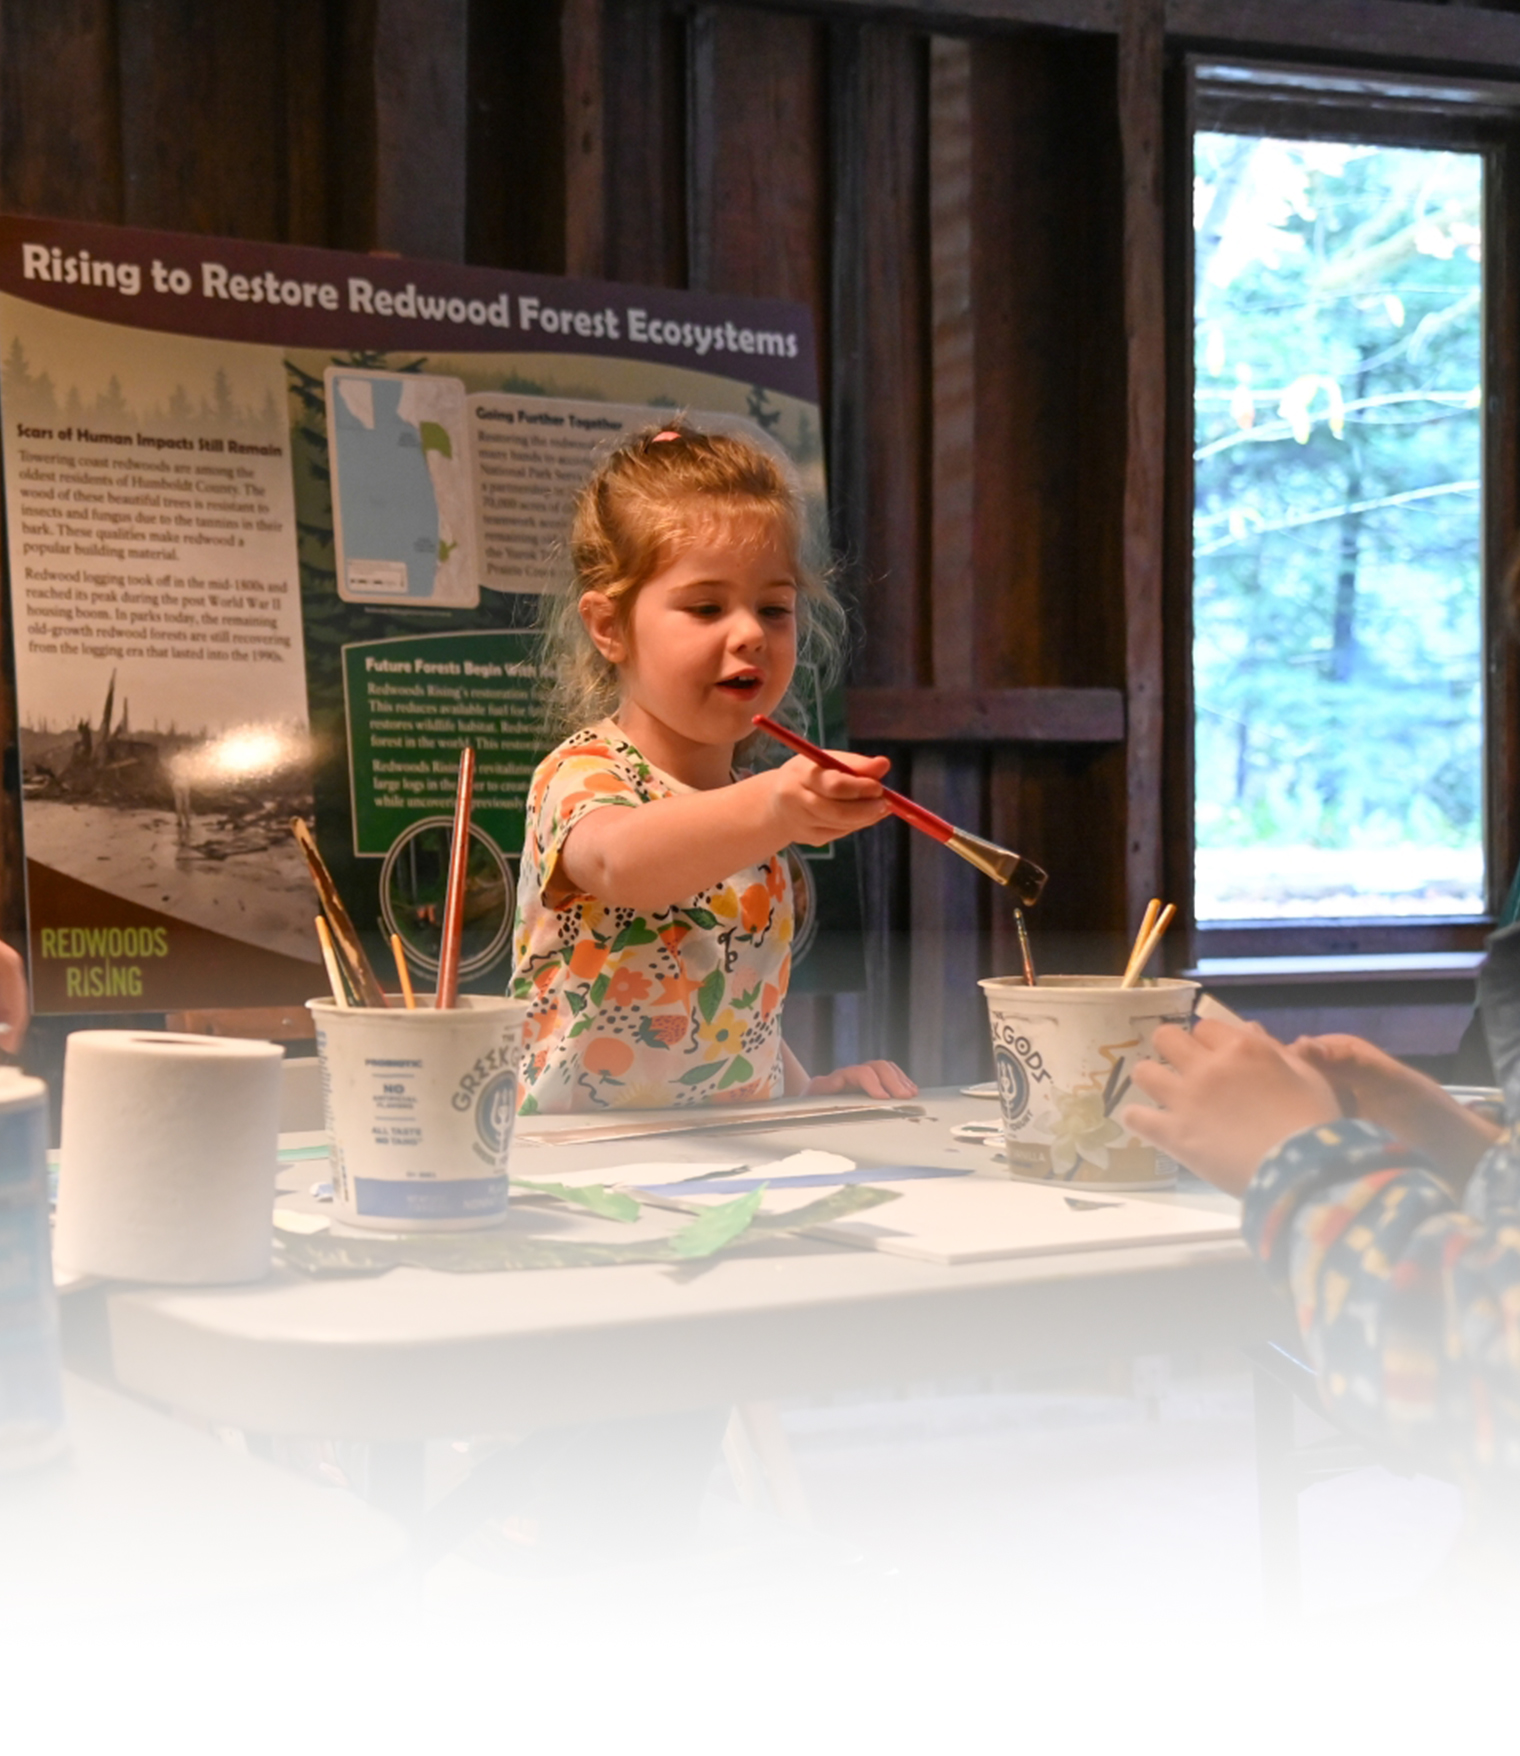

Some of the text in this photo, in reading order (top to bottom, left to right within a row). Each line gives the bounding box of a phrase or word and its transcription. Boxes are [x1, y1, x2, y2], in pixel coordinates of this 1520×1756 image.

[22, 243, 799, 358] Rising to Restore Redwood Forest Ecosystems
[476, 406, 622, 431] Going Further Together
[17, 423, 282, 457] Scars of Human Impacts Still Remain
[18, 450, 255, 481] Towering coast redwoods are among the
[19, 467, 56, 482] oldest
[59, 471, 113, 487] residents
[116, 473, 129, 487] of
[132, 475, 192, 492] Humboldt
[244, 482, 265, 497] The
[20, 487, 270, 514] wood of these beautiful trees is resistant to
[21, 503, 283, 533] insects and fungus due to the tannins in their
[21, 521, 245, 548] bark. These qualities make redwood a
[23, 540, 72, 557] popular
[74, 541, 125, 561] building
[25, 567, 287, 594] Redwood logging took off in the mid-1800s and
[26, 586, 281, 611] reached its peak during the post World War II
[26, 603, 73, 621] housing
[115, 607, 127, 620] In
[130, 609, 161, 625] parks
[164, 611, 200, 627] today,
[201, 611, 218, 625] the
[221, 616, 278, 631] remaining
[27, 621, 291, 650] old-growth redwood forests are still recovering
[28, 640, 58, 654] from
[60, 641, 78, 655] the
[81, 642, 124, 660] logging
[126, 647, 144, 658] era
[146, 645, 168, 659] that
[171, 646, 204, 661] lasted
[207, 648, 229, 661] into
[231, 648, 248, 662] the
[365, 656, 412, 674] Future
[414, 658, 461, 676] Forests
[463, 660, 502, 680] Begin
[504, 663, 537, 678] With
[367, 682, 425, 697] Redwoods
[427, 684, 469, 700] Rising's
[471, 687, 528, 701] restoration
[369, 699, 393, 714] This
[396, 701, 437, 715] reduces
[439, 702, 486, 717] available
[488, 703, 509, 718] fuel
[510, 704, 525, 718] for
[369, 719, 498, 734] restores wildlife habitat.
[370, 734, 402, 748] forest
[405, 735, 416, 748] in
[418, 735, 435, 749] the
[476, 738, 499, 751] This
[372, 759, 430, 774] Redwoods
[373, 777, 400, 792] large
[402, 777, 426, 792] logs
[428, 778, 438, 791] in
[487, 781, 499, 793] to
[374, 795, 405, 808] while
[41, 926, 169, 958] REDWOODS
[66, 958, 144, 998] RISING
[383, 1083, 406, 1096] NO
[372, 1126, 422, 1138] ALL TASTE
[375, 1137, 390, 1146] NO
